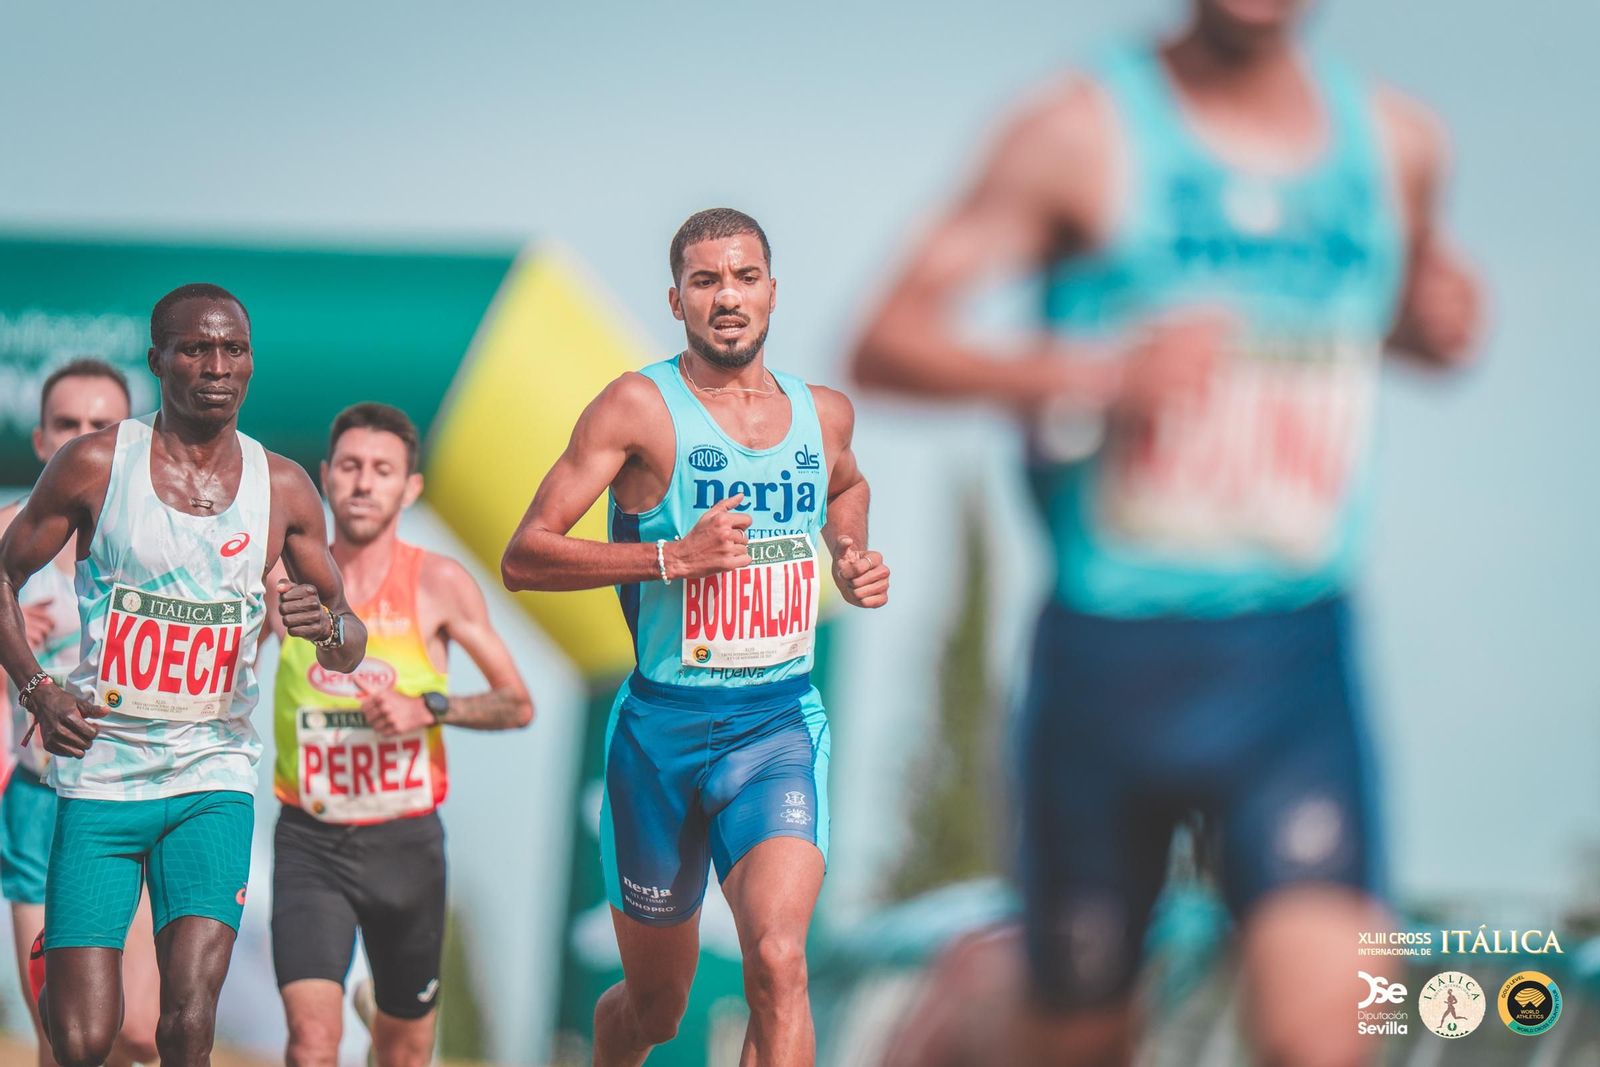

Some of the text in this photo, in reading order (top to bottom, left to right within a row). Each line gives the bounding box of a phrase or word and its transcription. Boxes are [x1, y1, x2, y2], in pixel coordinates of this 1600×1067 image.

[691, 450, 727, 467] TROPS
[693, 470, 815, 523] nerja
[149, 600, 214, 621] ITÁLICA
[685, 560, 815, 641] BOUFALJAT
[100, 612, 242, 696] KOECH
[623, 876, 672, 898] nerja
